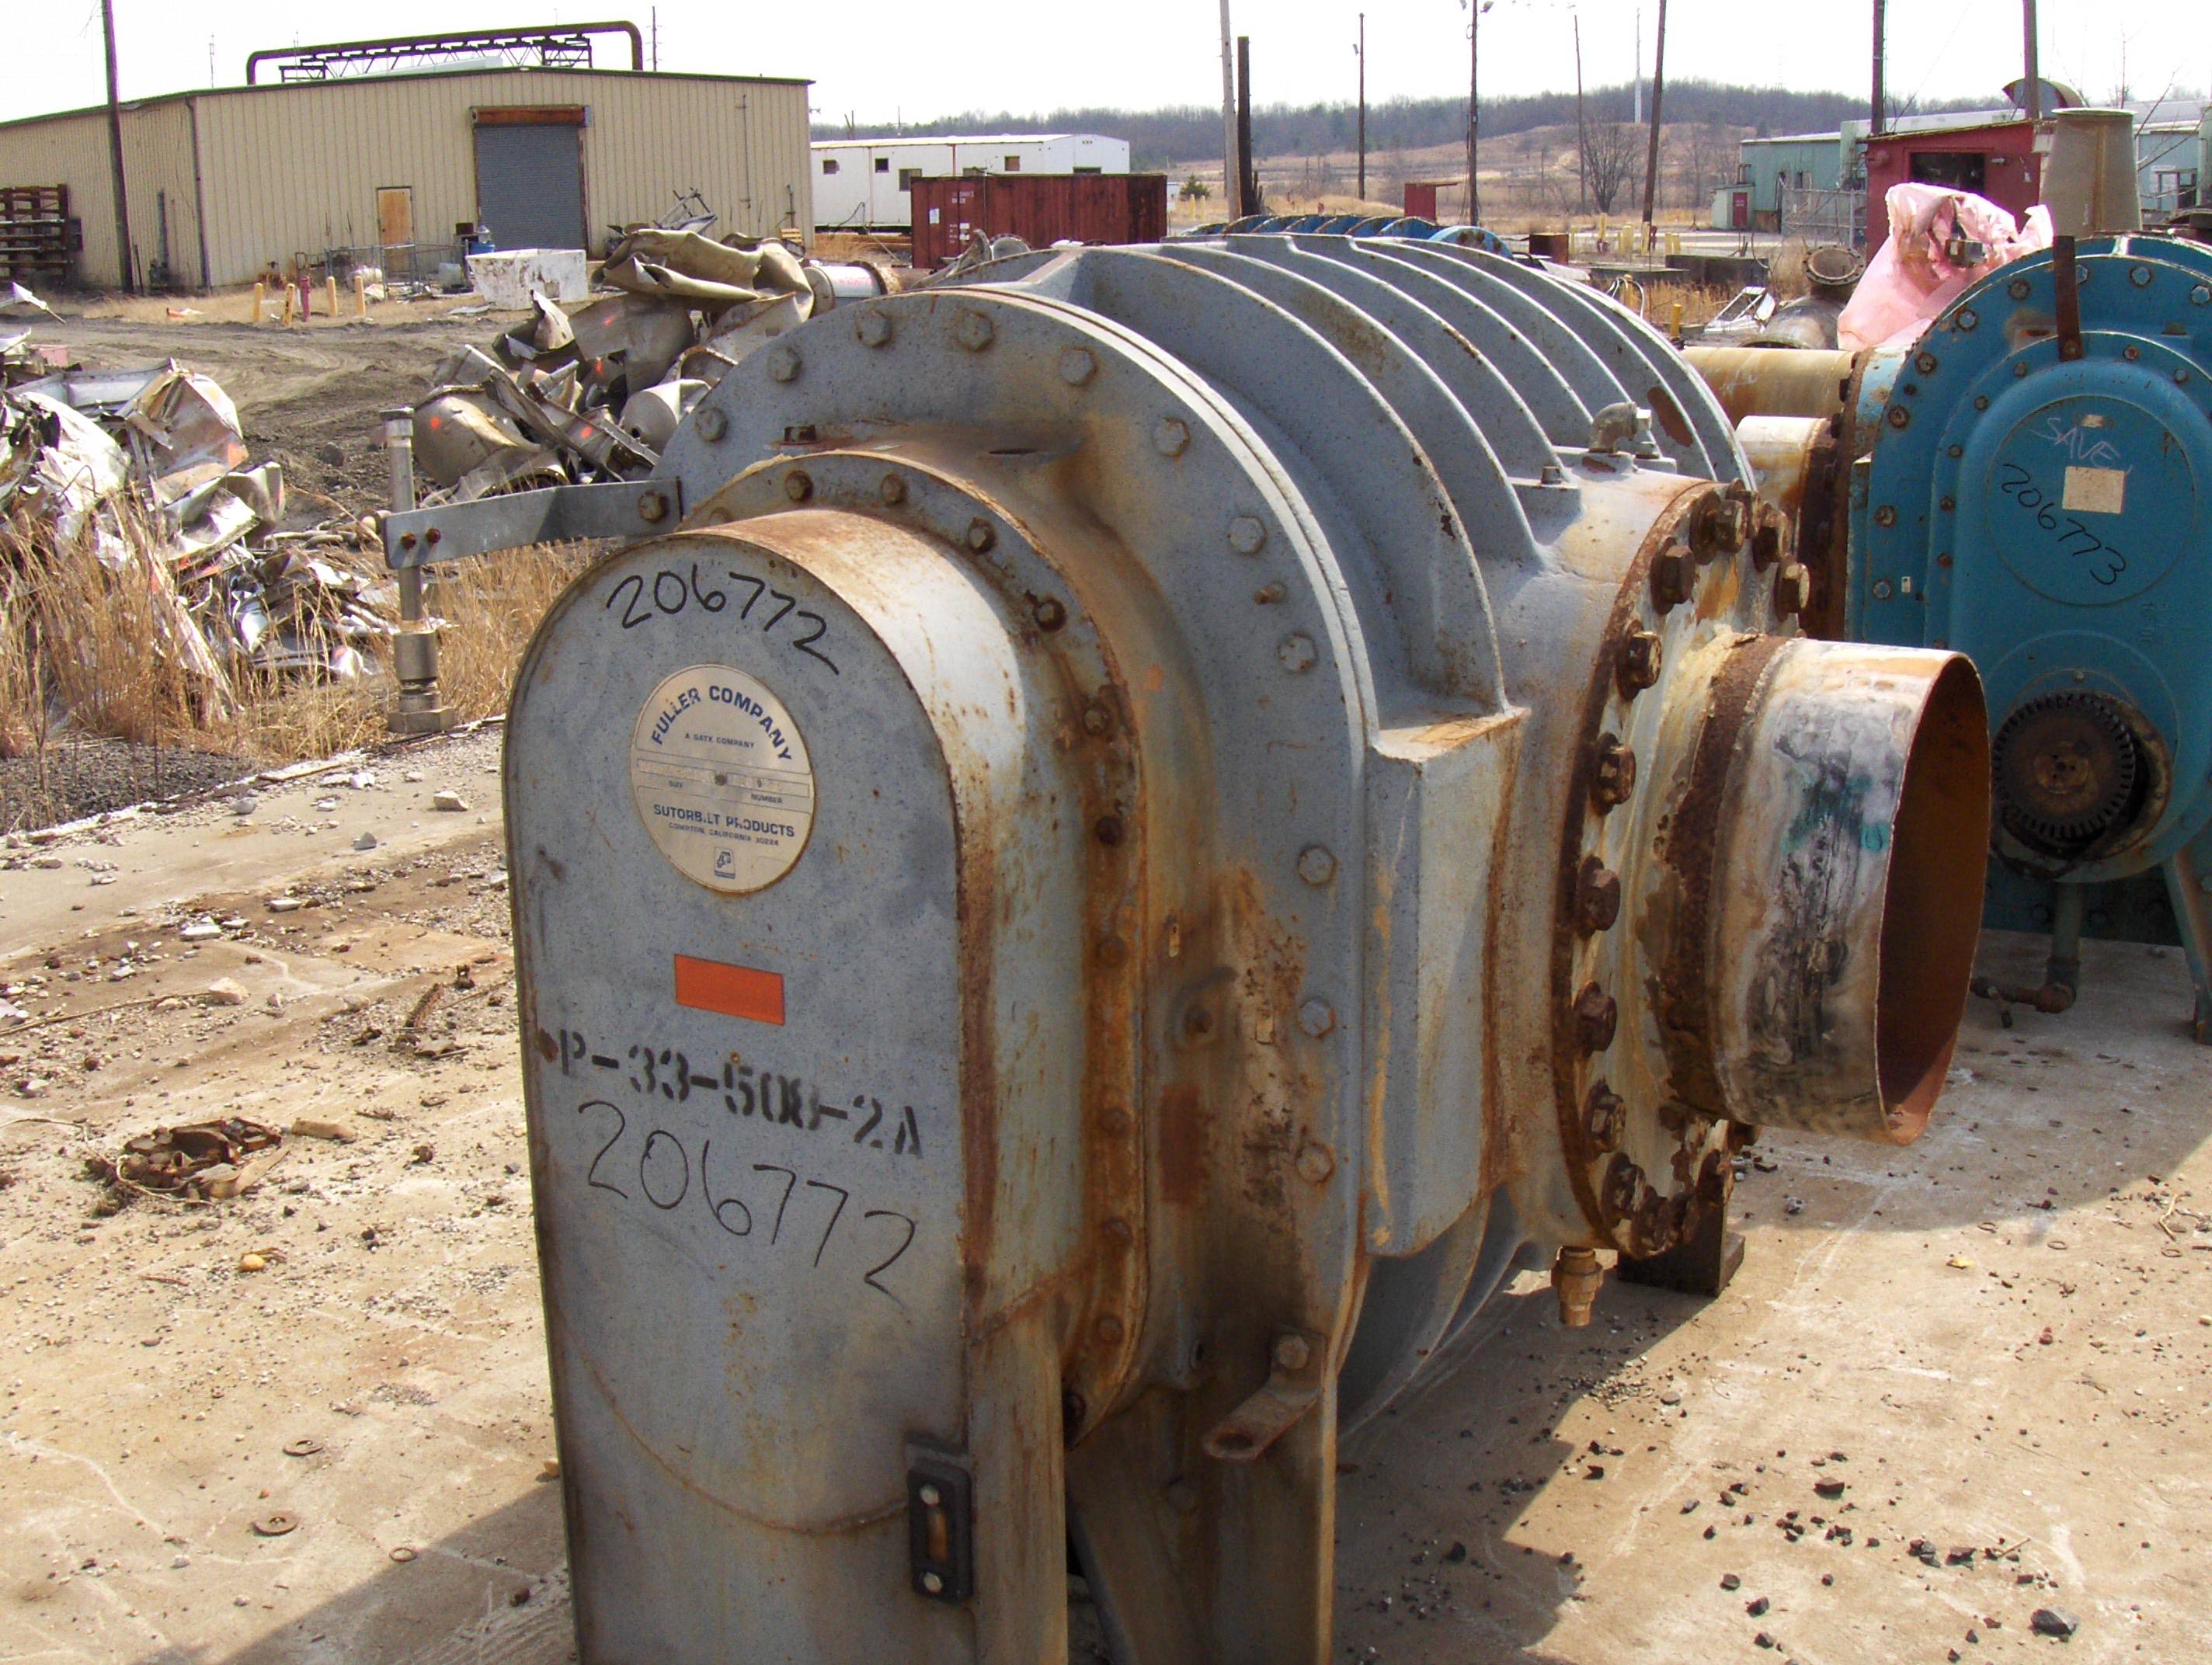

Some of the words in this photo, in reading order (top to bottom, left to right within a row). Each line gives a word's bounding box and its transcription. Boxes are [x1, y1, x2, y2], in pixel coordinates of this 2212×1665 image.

[2001, 463, 2126, 585] 206773
[607, 564, 840, 675] 206772
[651, 688, 701, 745] FULLER
[708, 685, 791, 760] COMPANY
[694, 734, 712, 742] GATX
[716, 736, 754, 748] COMPANY
[669, 780, 683, 788] SIZE
[751, 793, 783, 804] NUMBER
[725, 815, 795, 837] PRODUCTS
[579, 1100, 916, 1310] 206772
